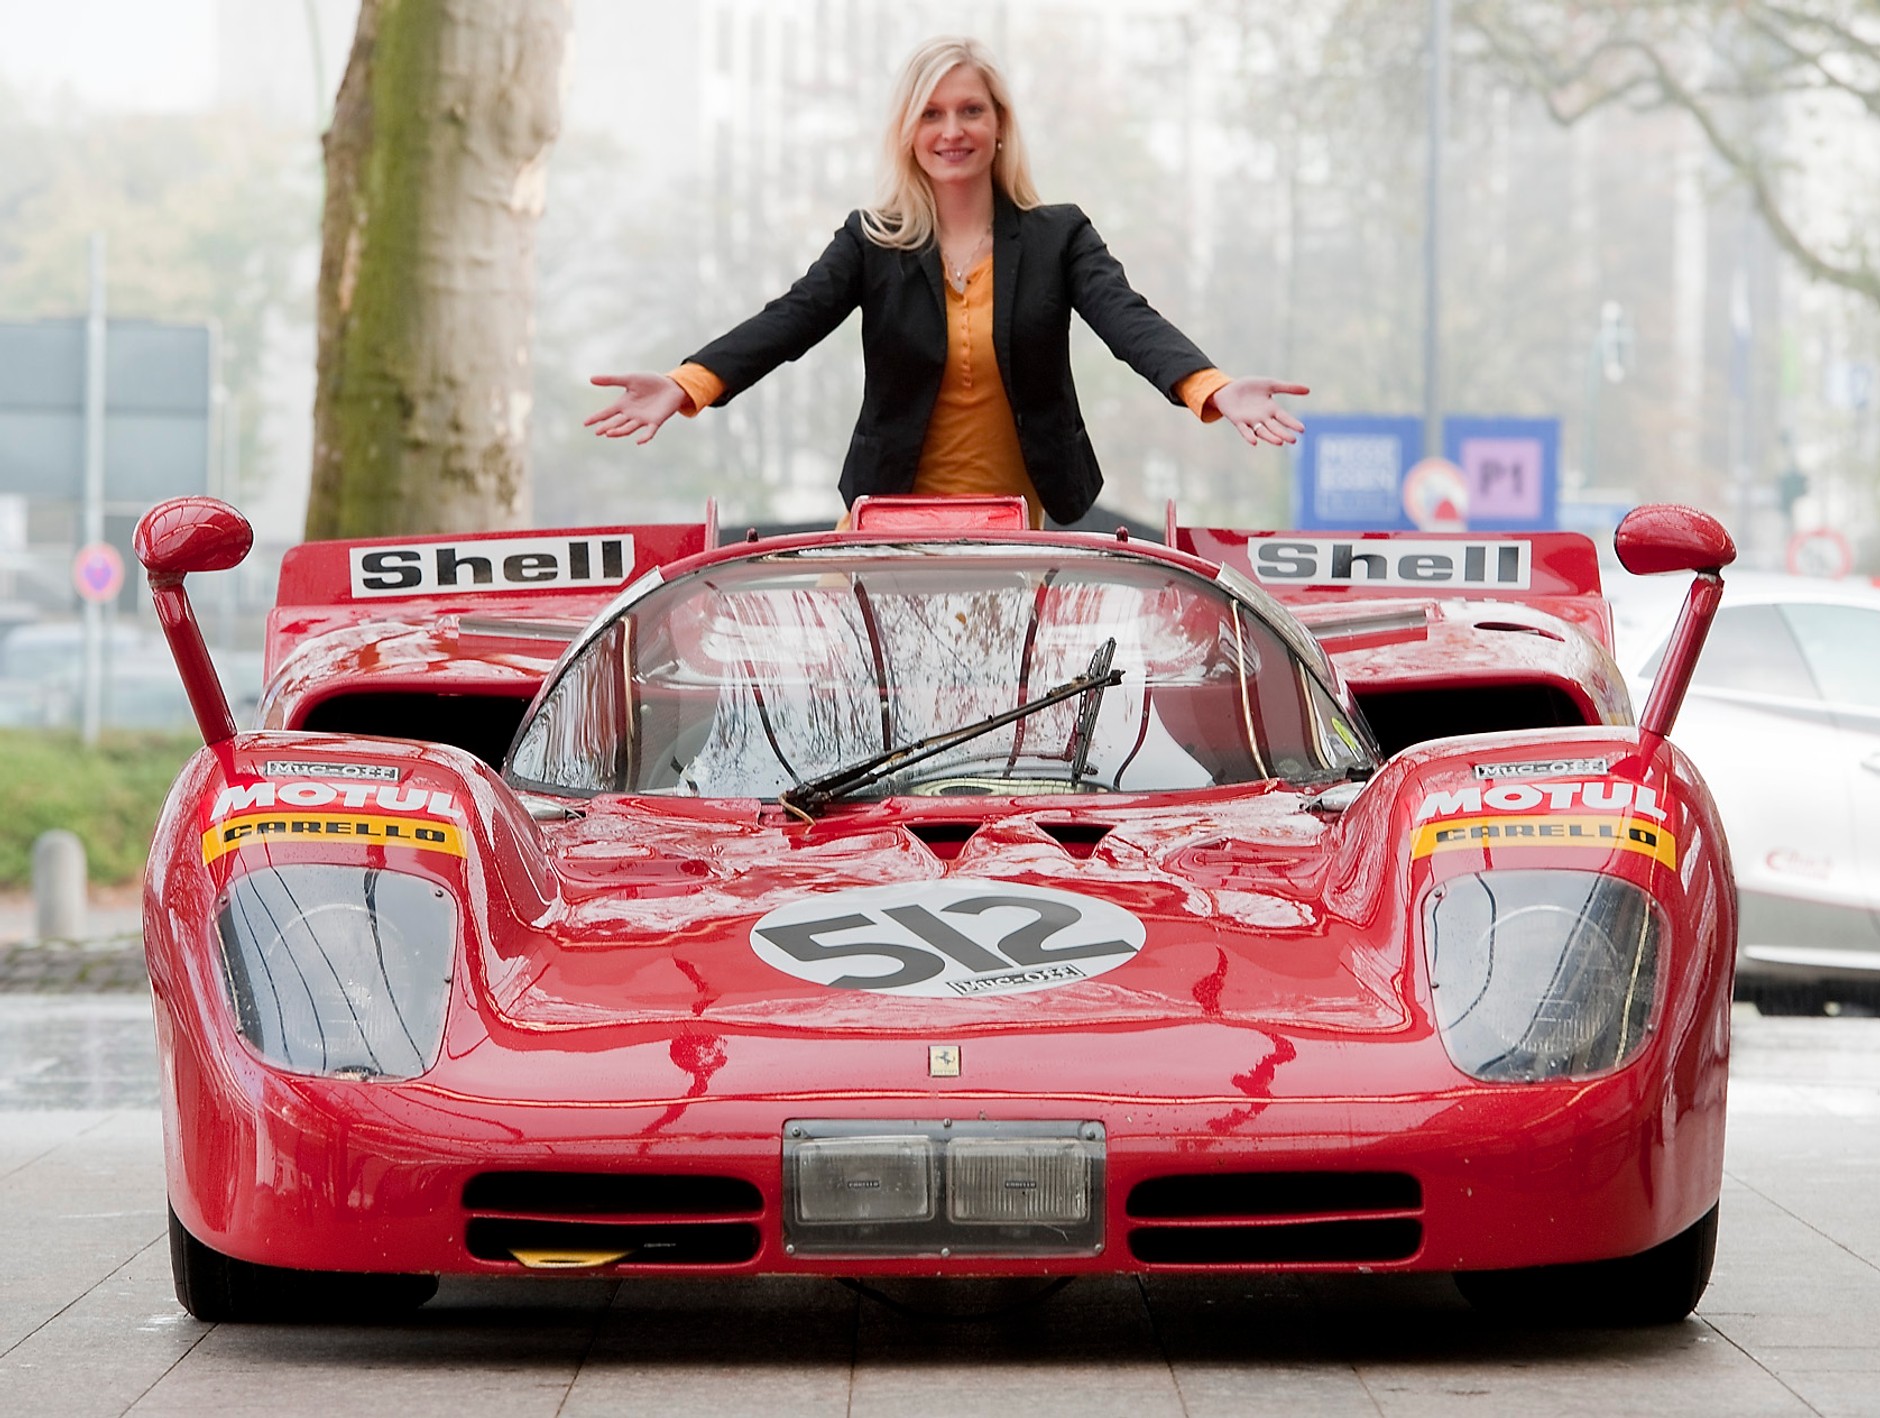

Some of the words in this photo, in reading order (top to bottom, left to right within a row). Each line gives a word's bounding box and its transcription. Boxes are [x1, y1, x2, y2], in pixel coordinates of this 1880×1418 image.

[1478, 460, 1525, 496] P1
[361, 540, 623, 589] Shell
[1257, 543, 1519, 582] Shell
[210, 782, 465, 821] MOTUL
[1416, 782, 1667, 821] MOTUL
[224, 821, 446, 843] CARELLO
[1436, 824, 1657, 847] CARELLO
[755, 896, 1138, 989] 512
